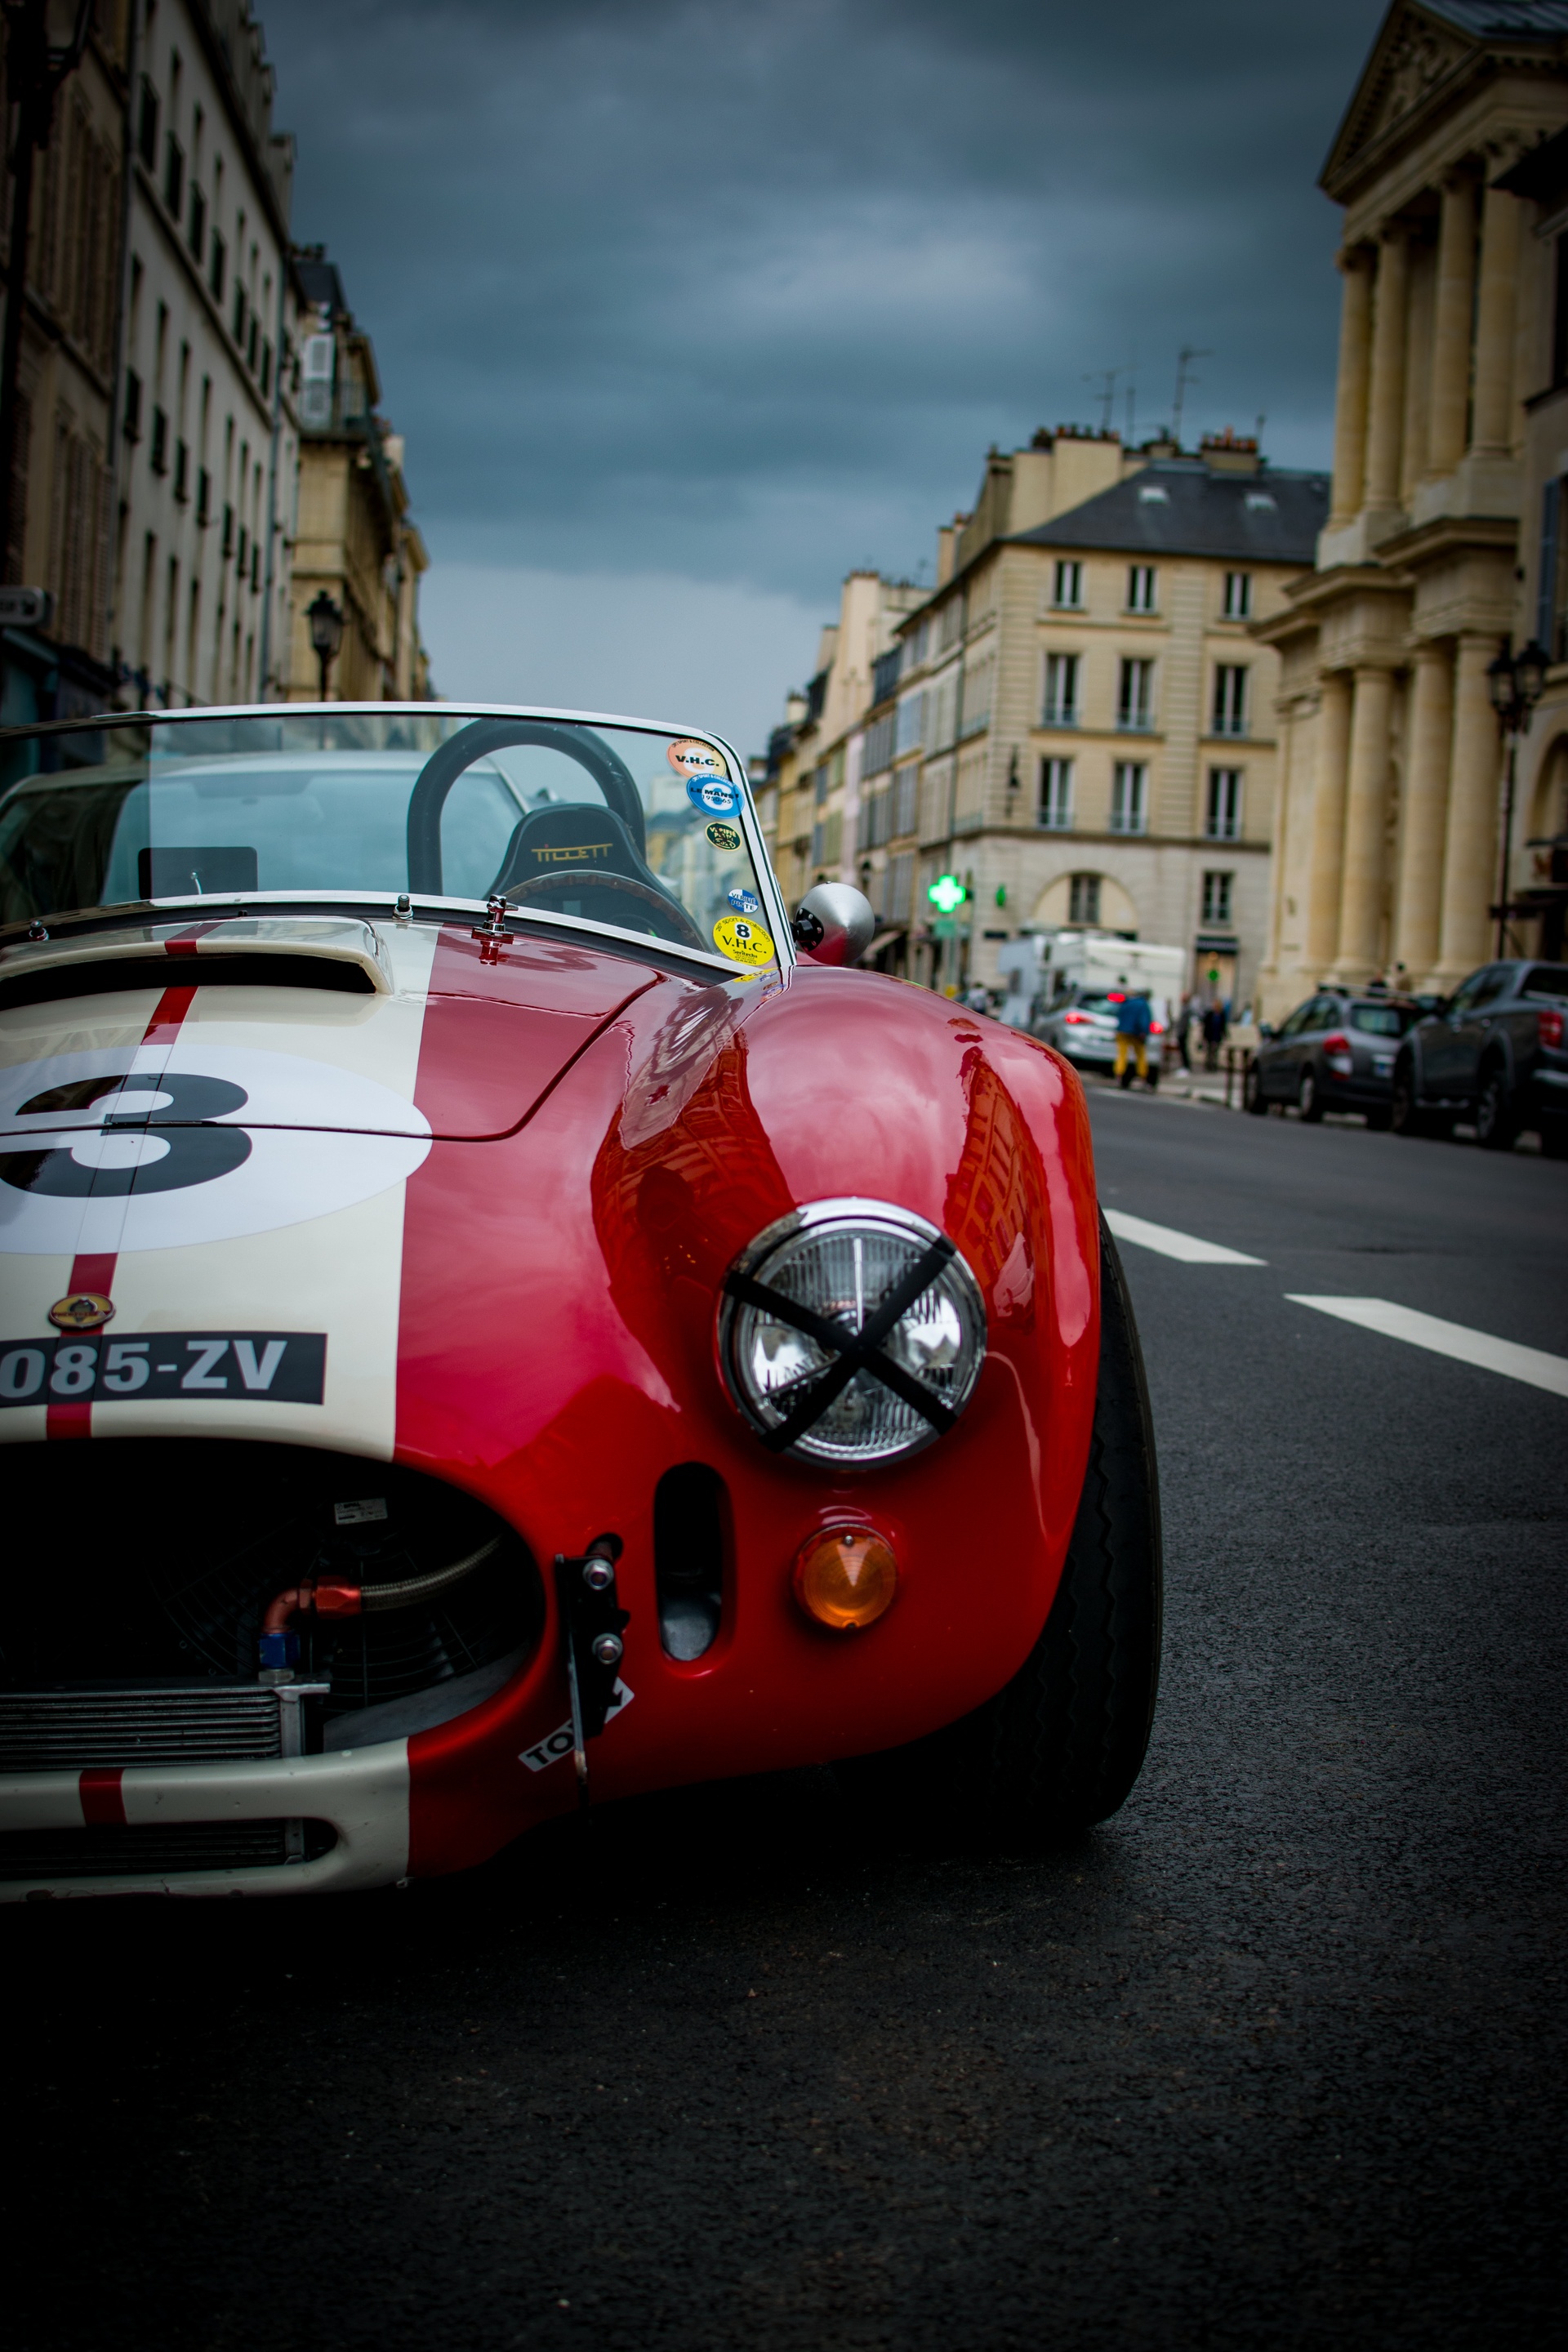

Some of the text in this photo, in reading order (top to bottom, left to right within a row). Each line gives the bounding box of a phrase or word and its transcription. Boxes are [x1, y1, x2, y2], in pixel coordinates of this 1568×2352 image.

[675, 755, 719, 767] V.H.C.
[702, 795, 732, 804] 1950-65
[704, 789, 734, 800] MANS
[731, 900, 755, 911] PISTE
[737, 924, 751, 938] 8
[722, 935, 767, 955] V.H.C.
[0, 1339, 287, 1400] 085-ZV
